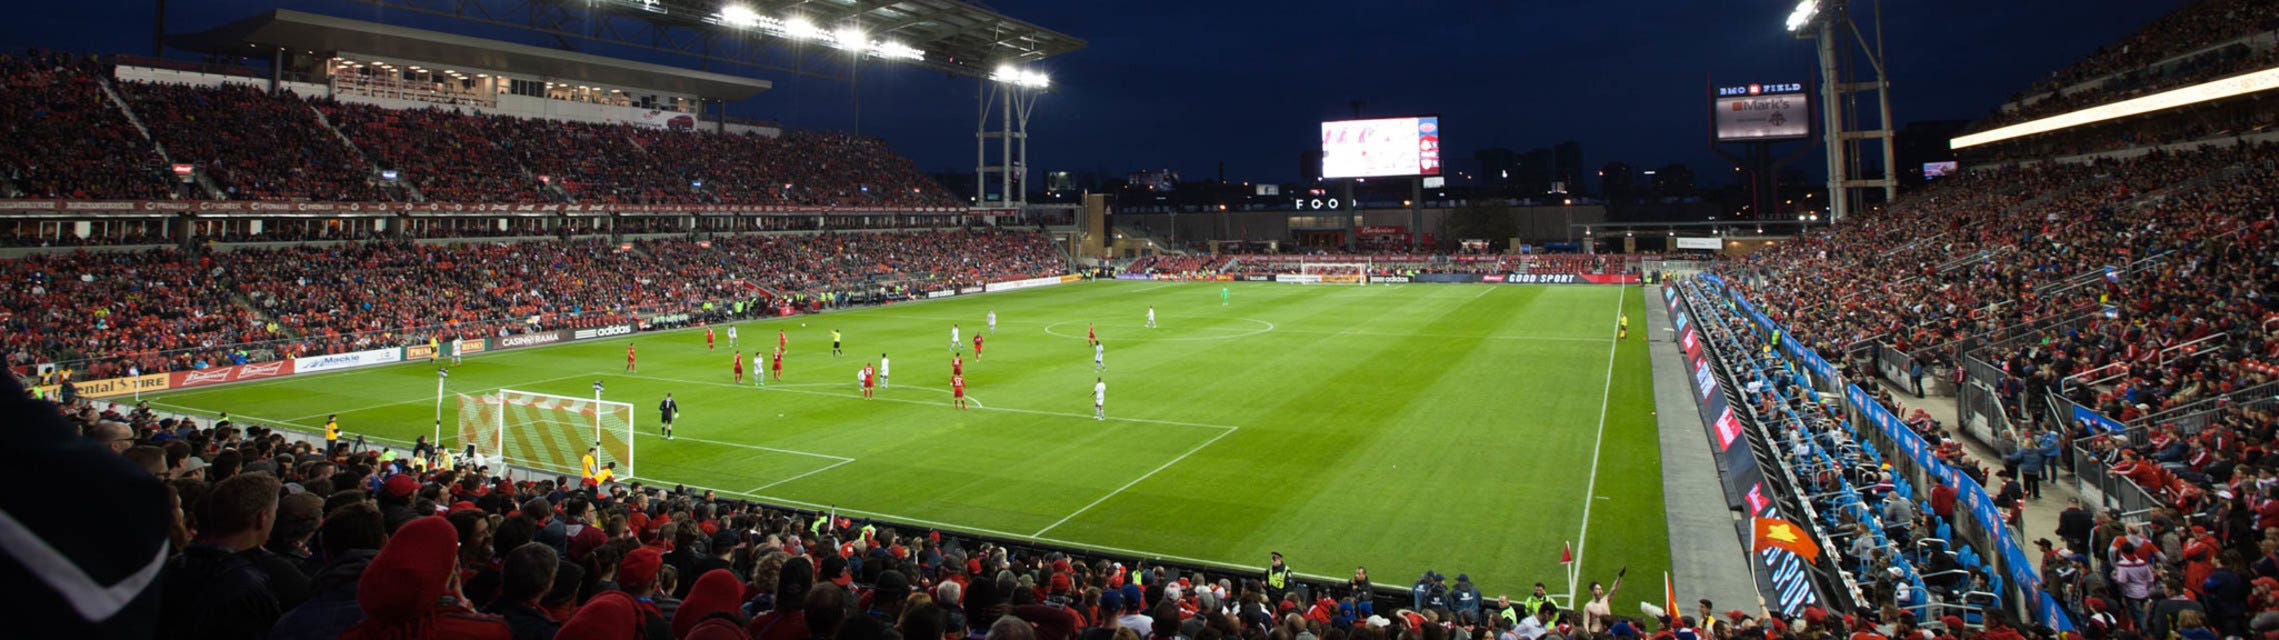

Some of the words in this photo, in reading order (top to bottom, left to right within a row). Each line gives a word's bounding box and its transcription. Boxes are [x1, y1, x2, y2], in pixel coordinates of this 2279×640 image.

[1720, 87, 1746, 95] BMO
[1763, 83, 1801, 92] FIELD
[1744, 100, 1790, 111] Mark's
[1509, 274, 1536, 282] GOOD
[1540, 274, 1574, 282] SPORT
[597, 324, 631, 336] adidas
[502, 335, 534, 346] CASINO
[535, 333, 559, 344] RAMA
[131, 377, 165, 389] TIRE
